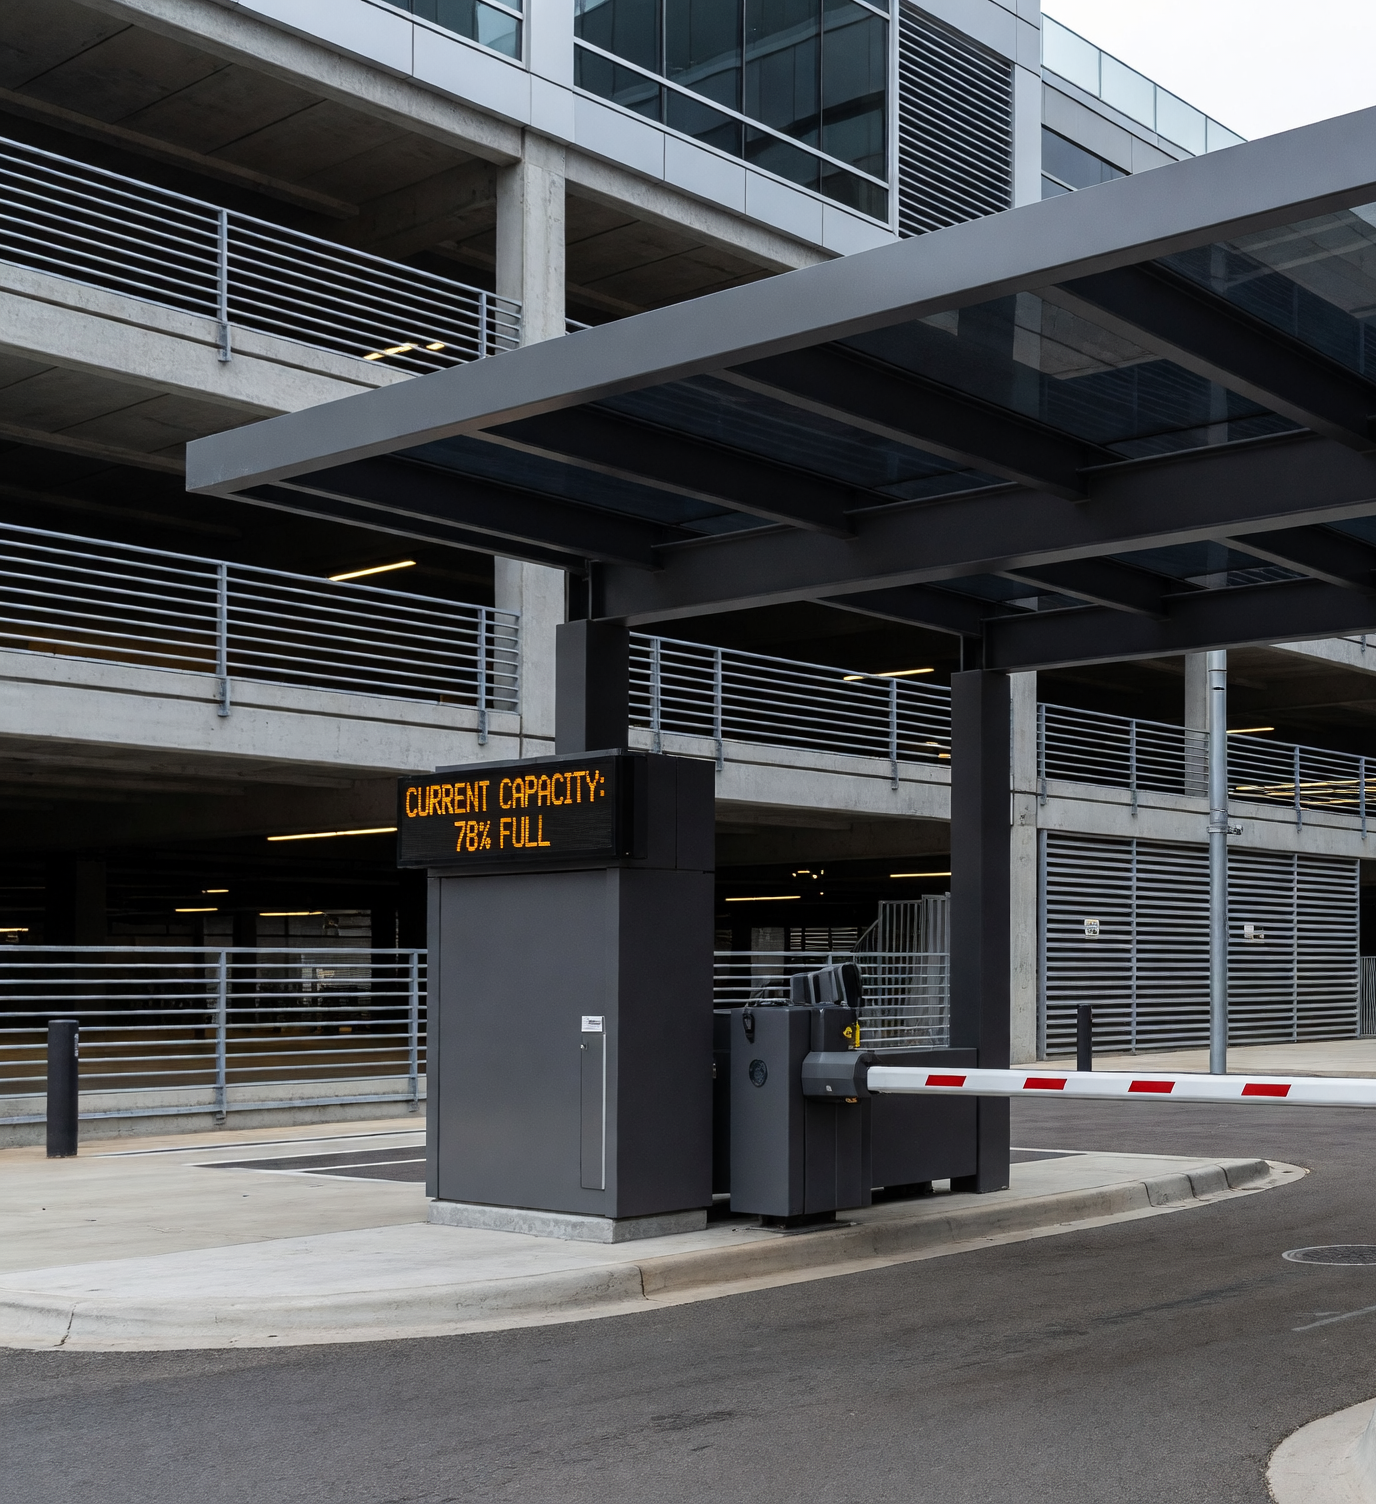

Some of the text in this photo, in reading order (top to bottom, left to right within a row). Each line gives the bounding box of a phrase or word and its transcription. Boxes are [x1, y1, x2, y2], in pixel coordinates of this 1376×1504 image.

[406, 770, 604, 817] CURRENT CAPACITY:
[454, 815, 550, 852] 78% FULL
